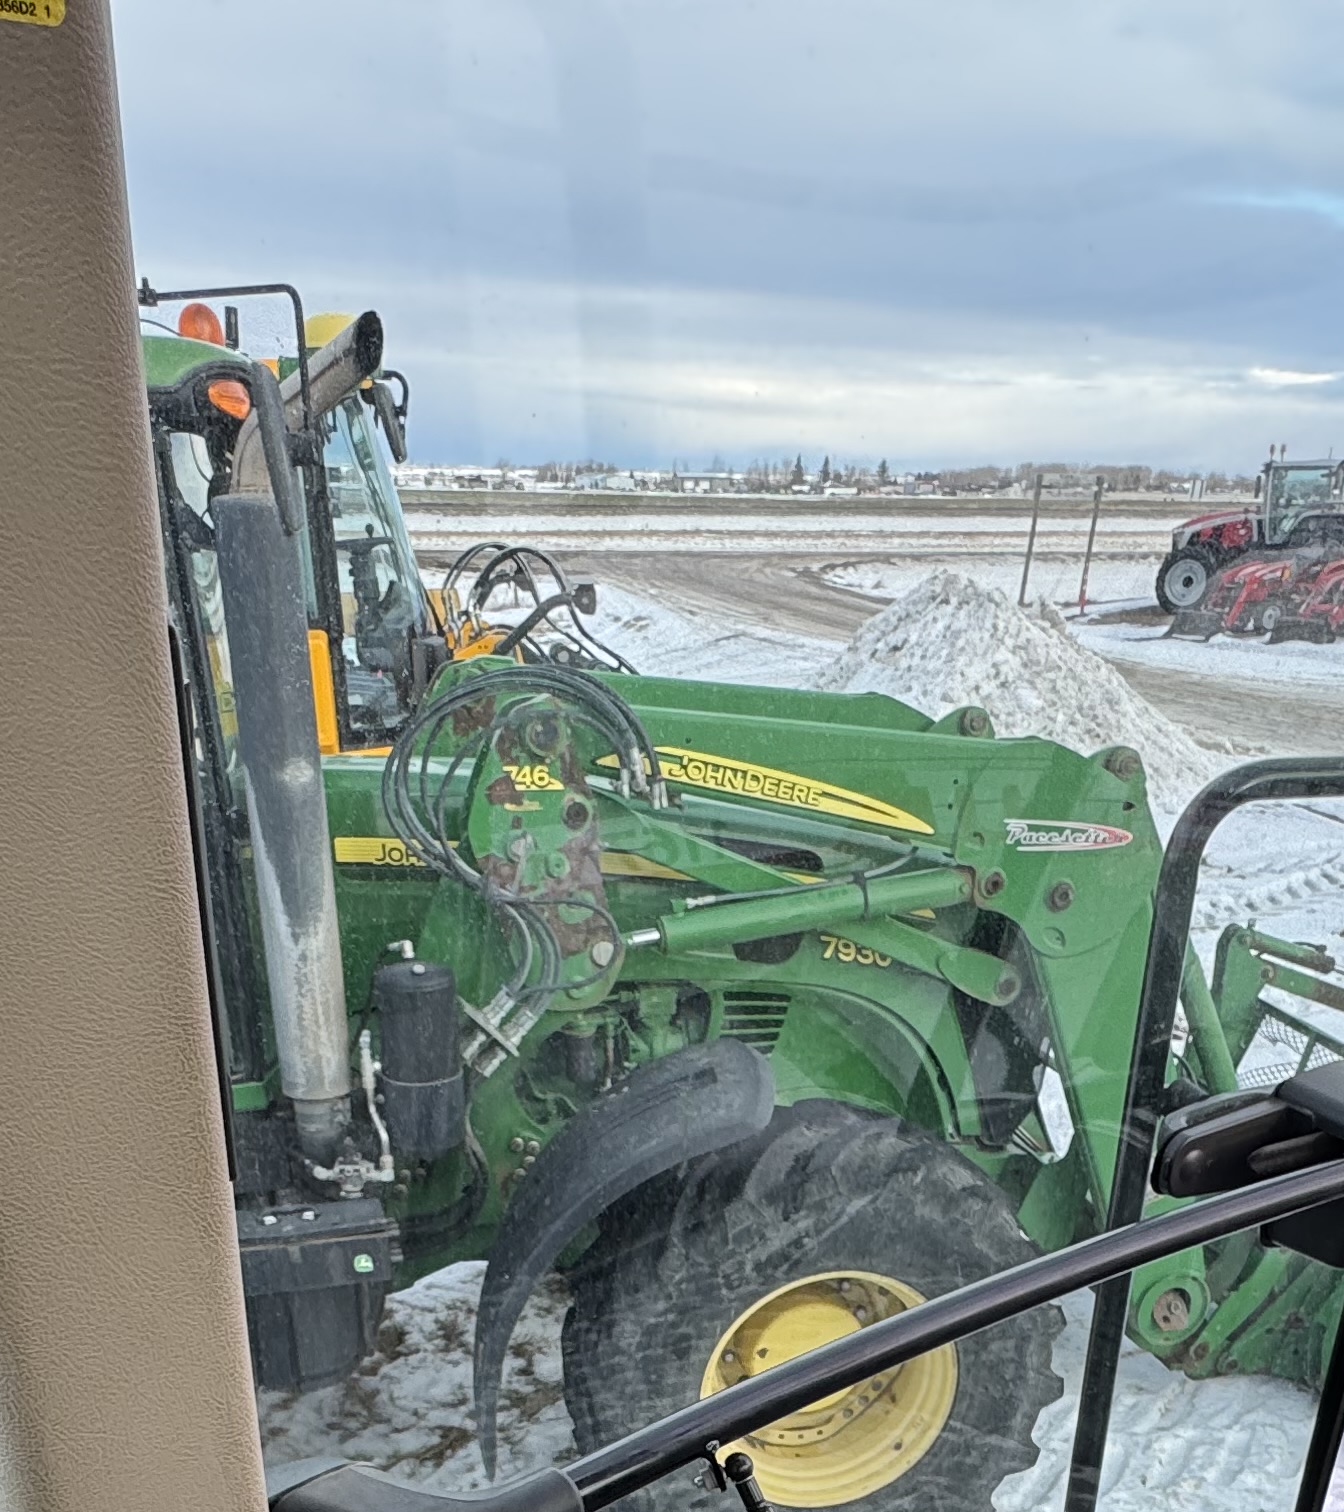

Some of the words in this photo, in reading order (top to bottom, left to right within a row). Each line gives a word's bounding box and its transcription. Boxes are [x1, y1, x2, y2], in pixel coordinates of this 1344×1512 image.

[44, 5, 51, 18] 1
[668, 755, 744, 790] JOHN
[744, 769, 823, 807] DEERE
[374, 843, 421, 863] JOH
